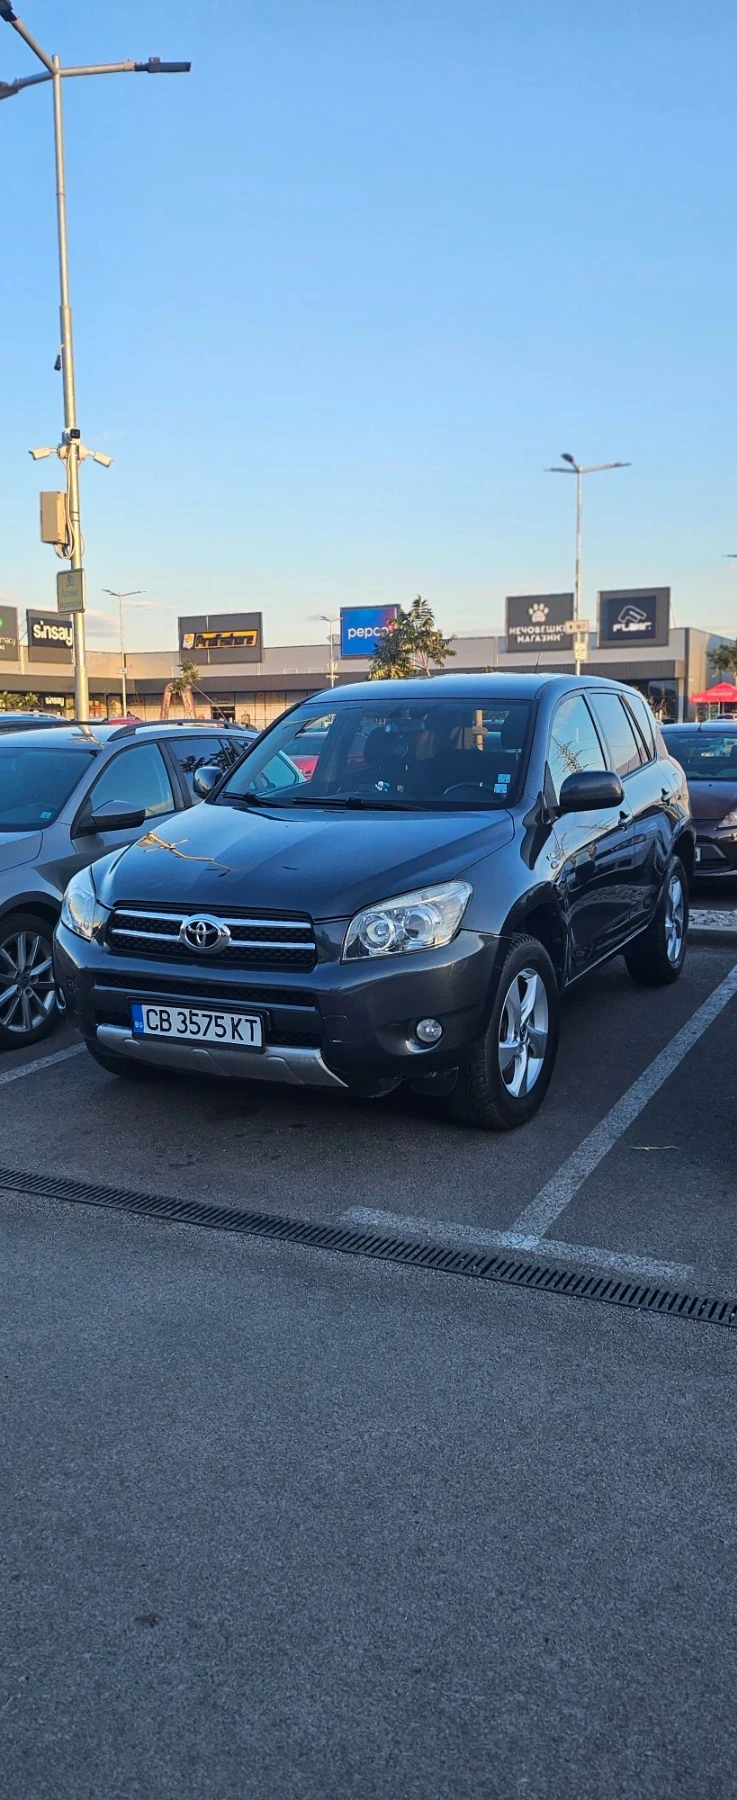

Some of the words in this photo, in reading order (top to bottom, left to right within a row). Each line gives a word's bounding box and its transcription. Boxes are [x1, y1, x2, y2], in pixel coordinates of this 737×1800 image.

[33, 620, 73, 647] sinsay
[517, 633, 561, 643] МАГАЗИН
[146, 1008, 172, 1032] CB
[176, 1010, 227, 1038] 3575
[230, 1016, 258, 1042] KT
